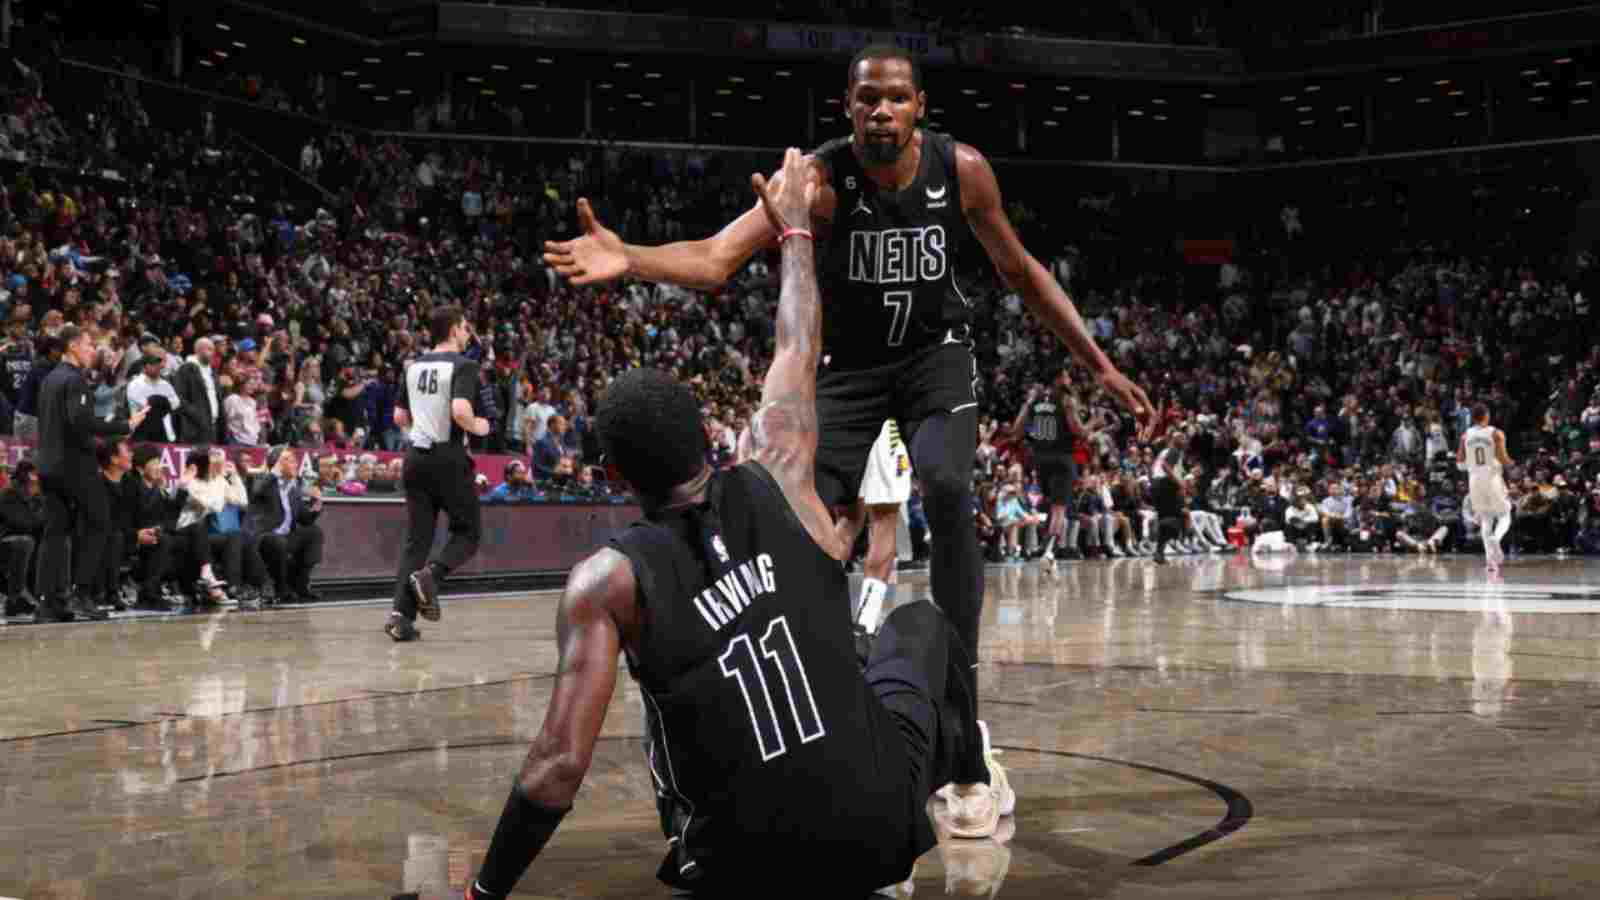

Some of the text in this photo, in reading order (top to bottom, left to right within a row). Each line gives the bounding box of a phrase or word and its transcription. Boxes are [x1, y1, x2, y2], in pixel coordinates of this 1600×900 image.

[849, 225, 946, 284] NETS
[883, 291, 912, 346] 7
[1474, 446, 1486, 466] 0
[693, 553, 777, 631] IRVING
[717, 616, 825, 762] 11
